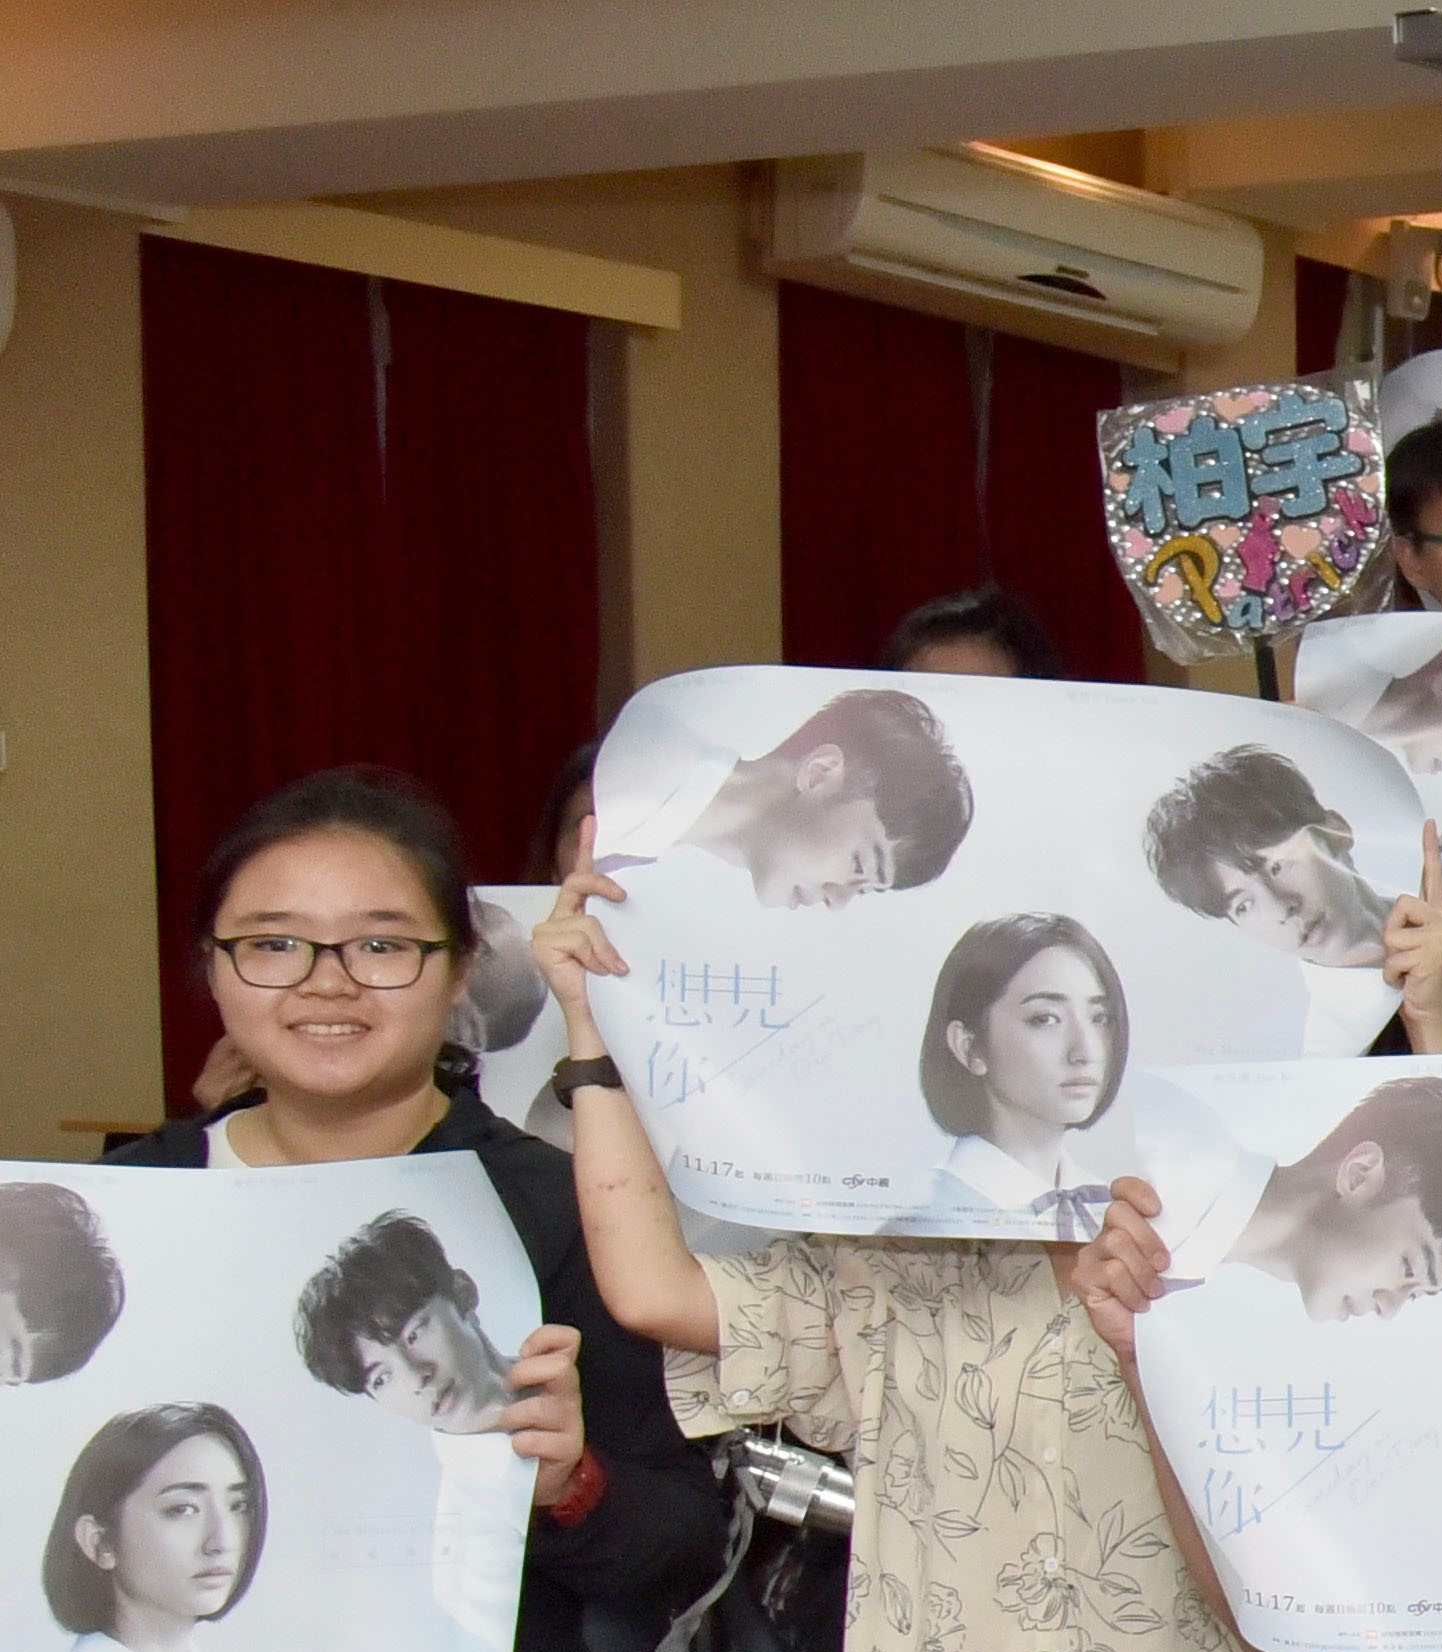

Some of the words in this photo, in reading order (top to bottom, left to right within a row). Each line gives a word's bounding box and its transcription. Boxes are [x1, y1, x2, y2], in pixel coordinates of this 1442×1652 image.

[1122, 394, 1364, 535] 柏宇
[646, 958, 791, 1028] 想見
[646, 1040, 707, 1104] 你
[1197, 1383, 1346, 1453] 想見
[1203, 1467, 1264, 1534] 你
